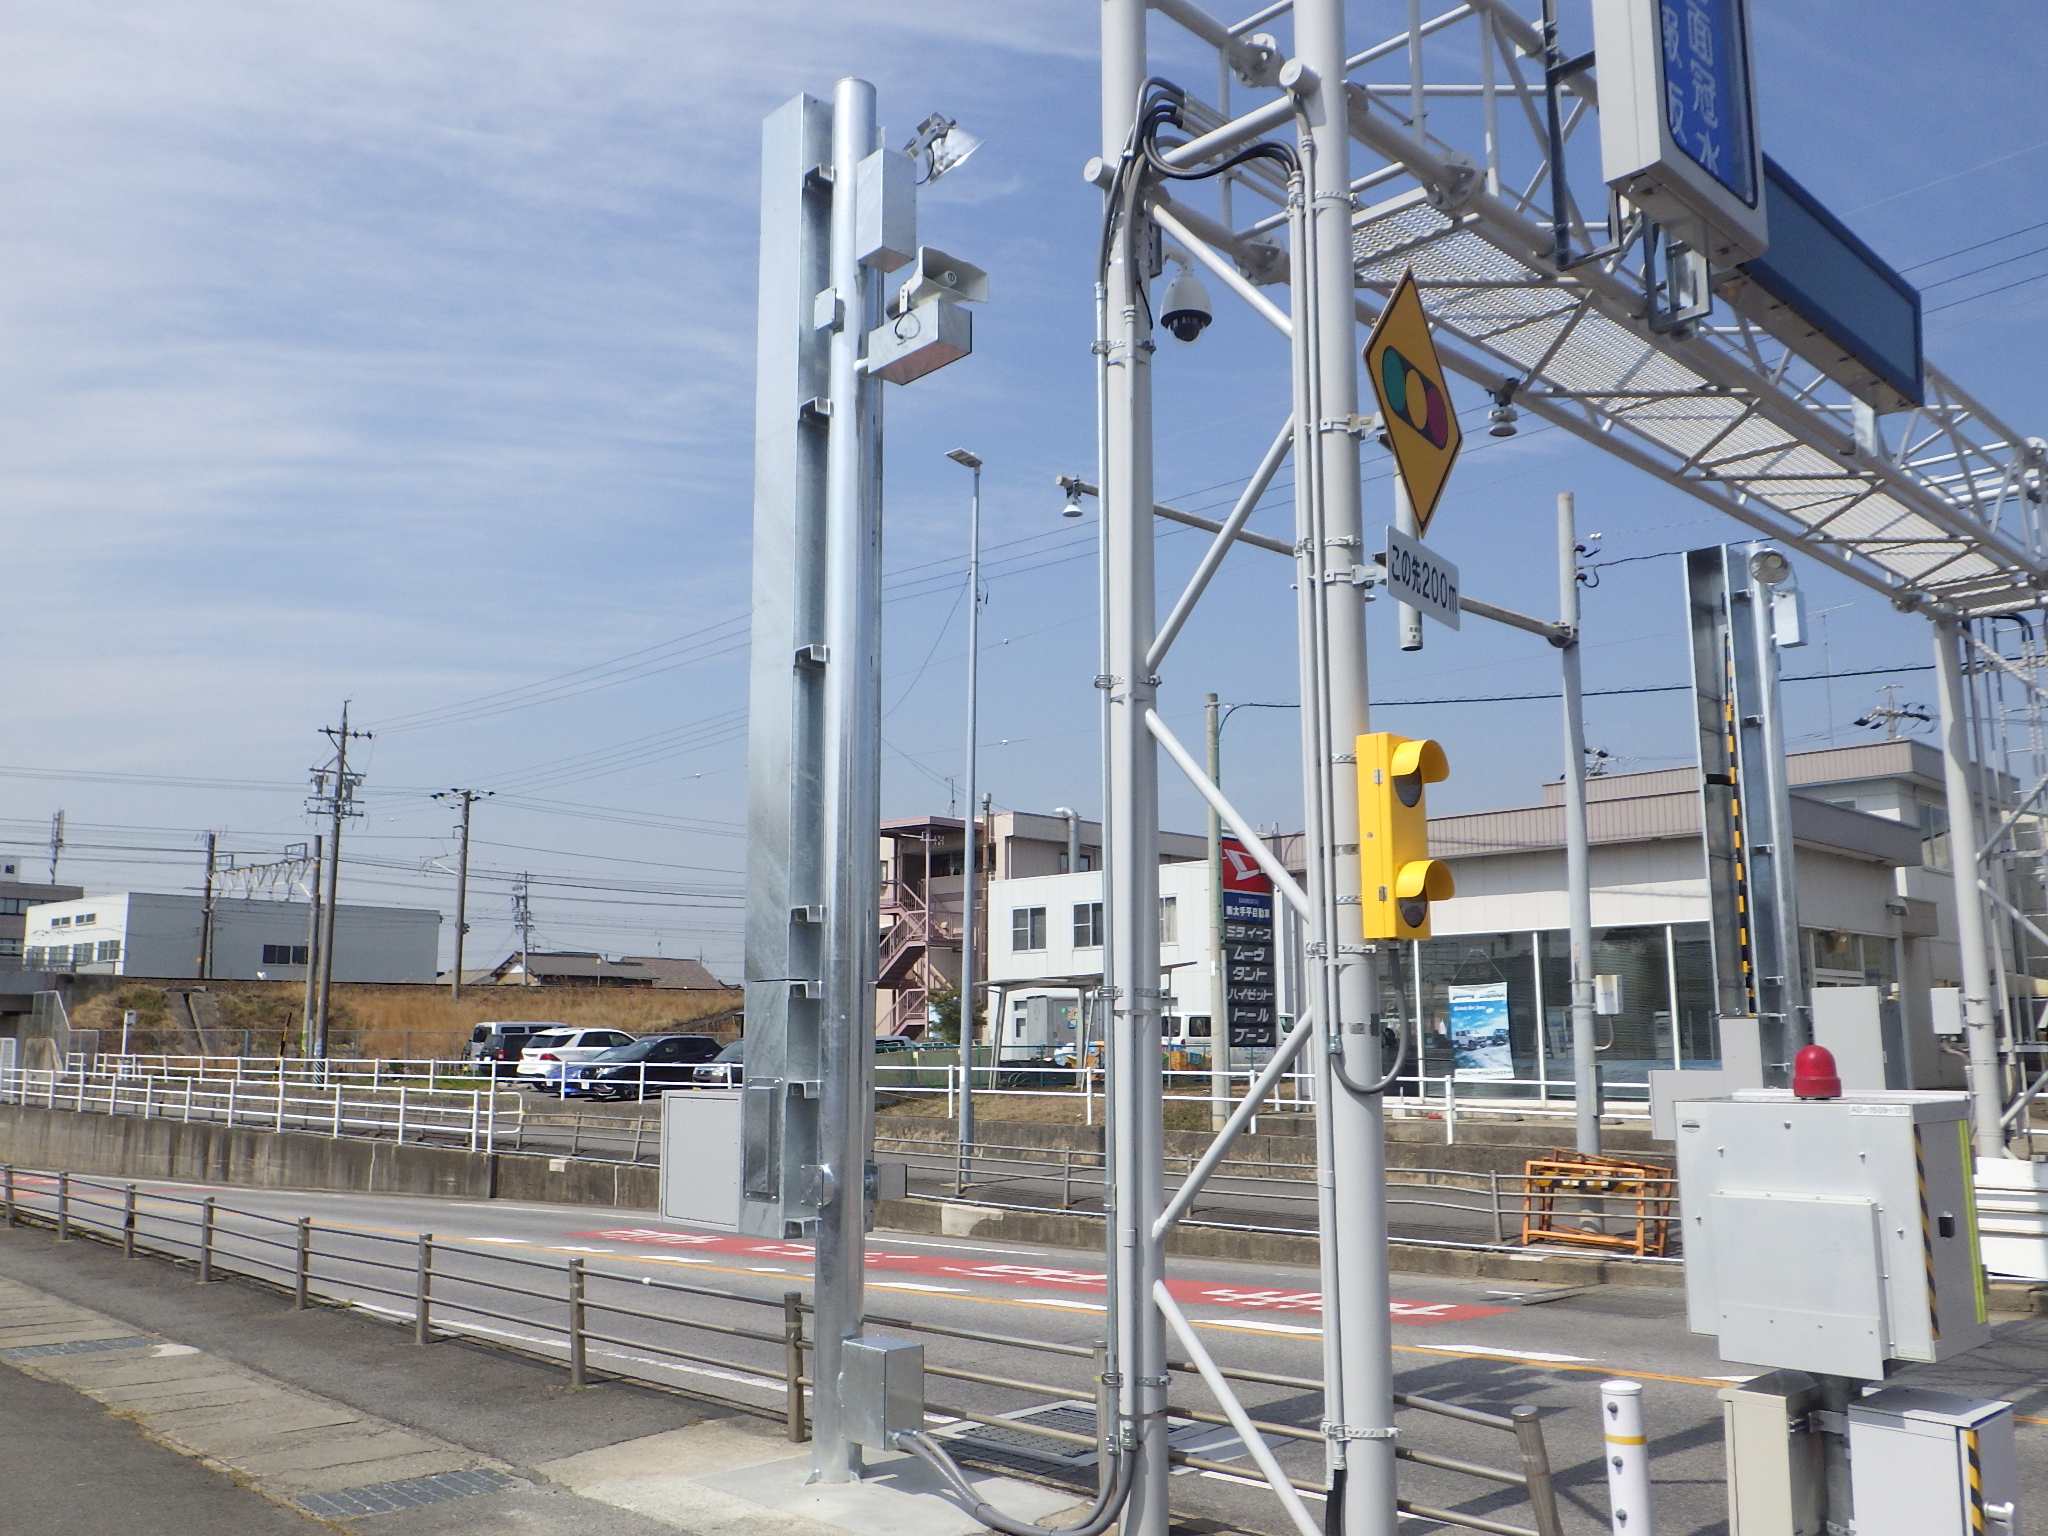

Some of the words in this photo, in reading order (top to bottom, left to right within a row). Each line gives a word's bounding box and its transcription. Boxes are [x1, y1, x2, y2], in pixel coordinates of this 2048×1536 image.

[1391, 544, 1458, 615] この先200m
[1233, 946, 1265, 962] ムーヴ
[1232, 966, 1268, 982] タント
[1228, 988, 1273, 1001] ハイゼット
[1233, 1007, 1269, 1023] トール
[1234, 1028, 1270, 1043] ブーン
